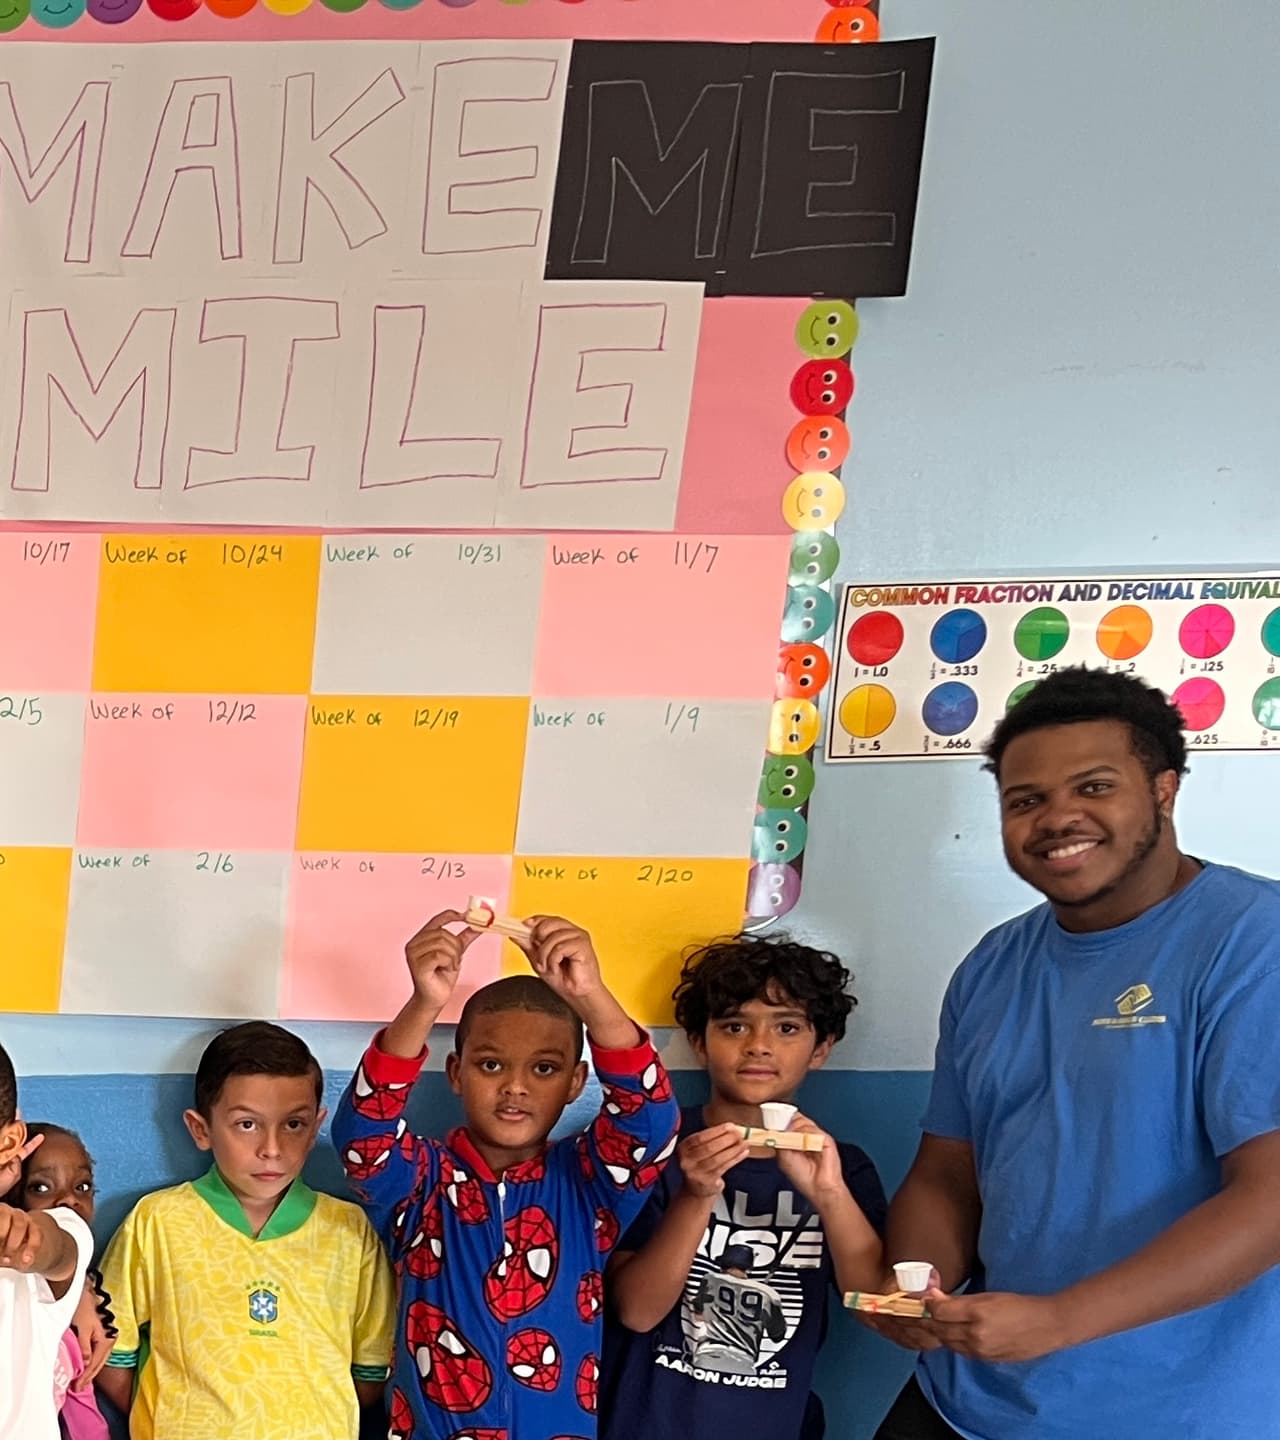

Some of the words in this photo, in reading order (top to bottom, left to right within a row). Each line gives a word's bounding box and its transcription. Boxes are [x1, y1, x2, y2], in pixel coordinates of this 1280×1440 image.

[570, 69, 906, 266] ME
[22, 540, 71, 565] 10/17
[165, 547, 188, 564] of
[221, 543, 284, 565] 10/24
[392, 543, 414, 560] of
[457, 543, 502, 565] 10/31
[616, 546, 639, 564] of
[673, 540, 719, 573] 11/7
[850, 586, 949, 607] COMMON
[953, 583, 1053, 605] FRACTION
[1057, 583, 1102, 601] AND
[1107, 581, 1195, 601] DECIMAL
[151, 702, 175, 720] of
[207, 700, 258, 724] 12/12
[366, 712, 383, 726] of
[413, 708, 459, 729] 12/19
[586, 711, 606, 727] of
[663, 702, 700, 732] 1/9
[132, 854, 151, 868] of
[196, 852, 235, 874] 2/6
[359, 860, 375, 872] of
[420, 856, 466, 880] 2/13
[577, 867, 598, 881] of
[636, 864, 694, 885] 2/20
[696, 1223, 824, 1269] ISE
[718, 1286, 764, 1321] 99
[654, 1354, 721, 1384] AARON
[722, 1374, 788, 1389] JUDGE
